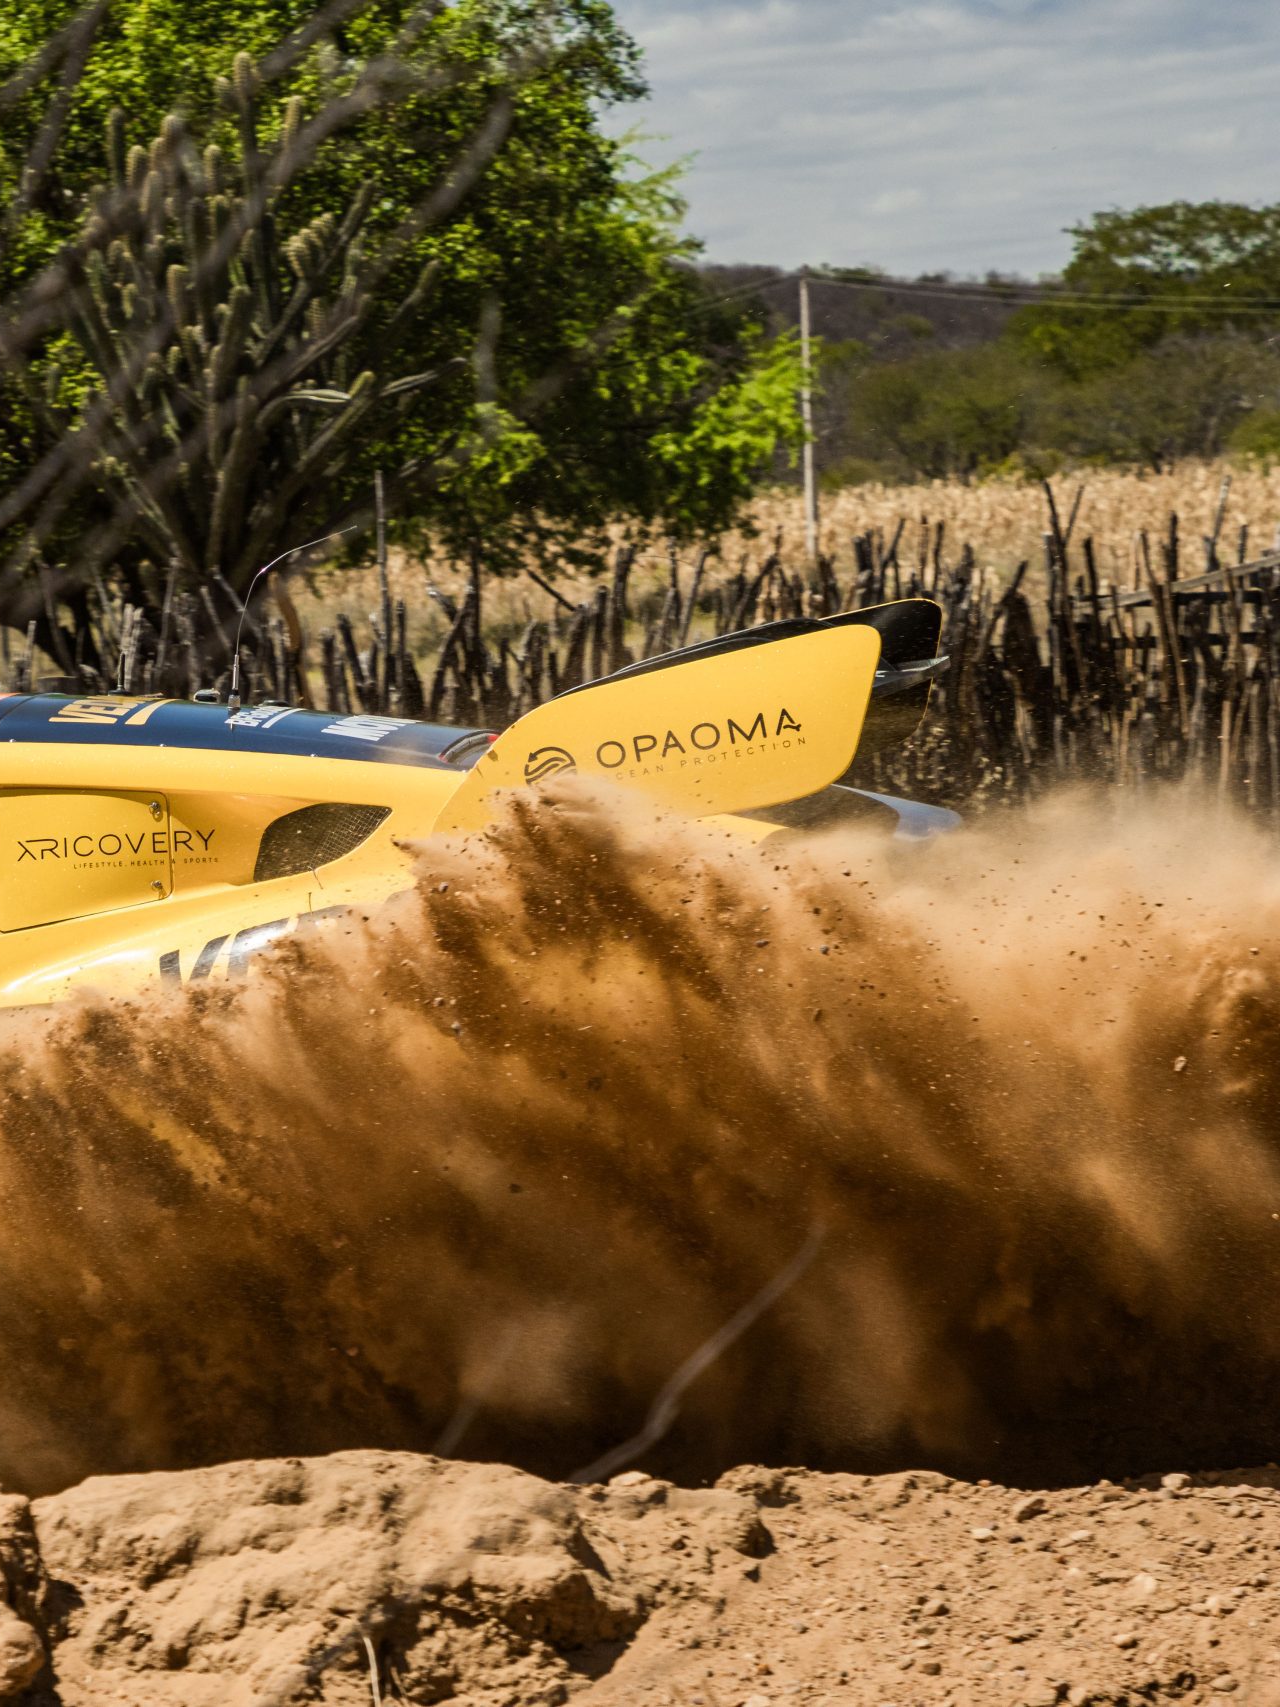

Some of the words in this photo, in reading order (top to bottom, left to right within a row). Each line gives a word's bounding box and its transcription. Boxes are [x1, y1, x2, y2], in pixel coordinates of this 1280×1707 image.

[596, 708, 803, 769] OPAOMA
[680, 736, 807, 768] PROTECTION
[17, 828, 216, 862] XRICOVERY
[130, 859, 166, 867] HEALTH
